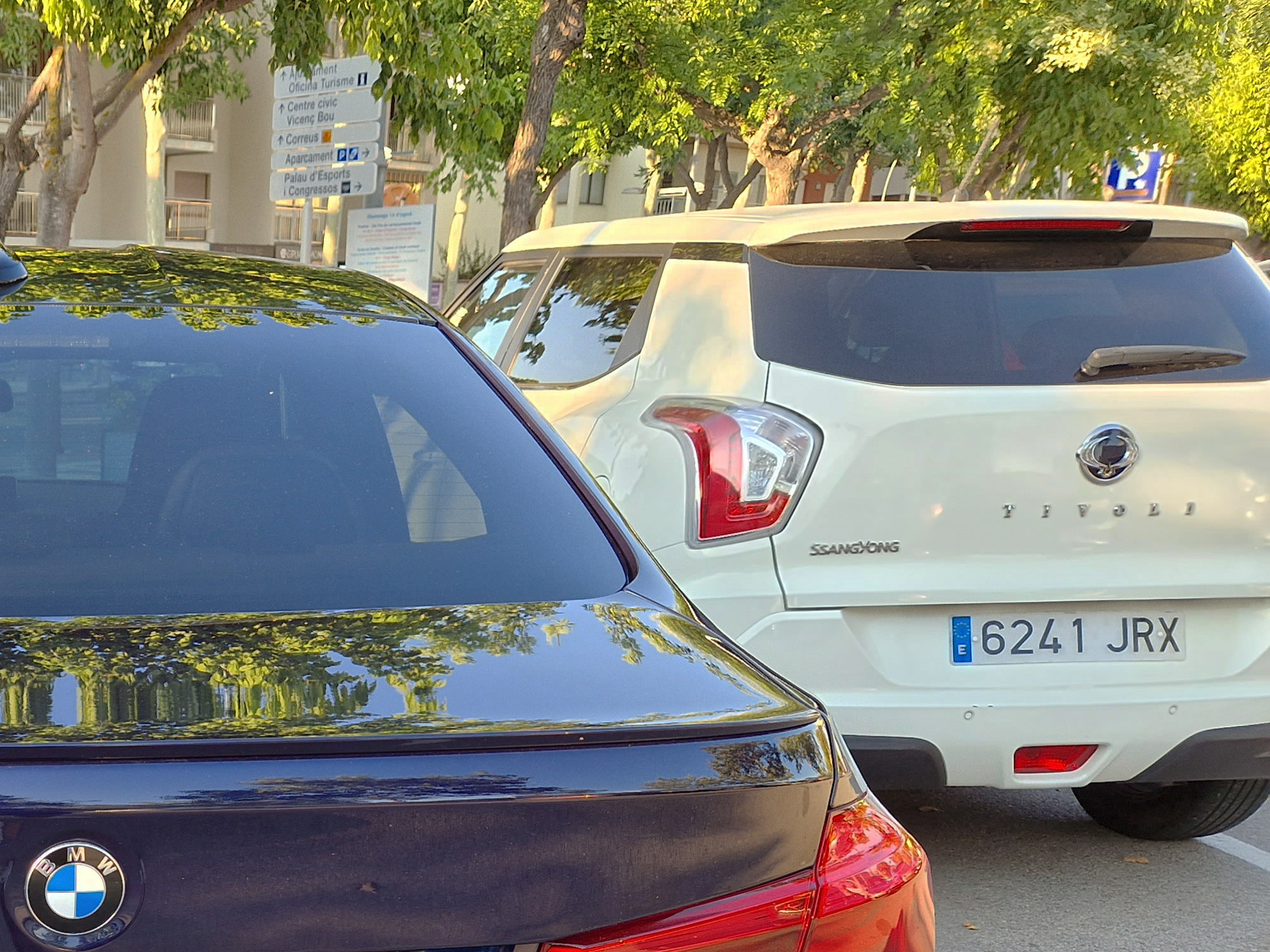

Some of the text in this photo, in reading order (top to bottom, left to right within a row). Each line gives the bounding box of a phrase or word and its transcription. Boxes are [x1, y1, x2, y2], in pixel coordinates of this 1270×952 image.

[289, 64, 338, 81] Ajuament
[288, 81, 317, 93] Oficina
[321, 76, 354, 90] Turisme
[287, 100, 315, 112] Centre
[287, 111, 335, 127] Vicenç Bou
[286, 133, 319, 145] Correus
[285, 150, 333, 166] Aparcament
[285, 169, 350, 183] Palau d'Esports
[288, 184, 338, 197] Congressos
[1002, 502, 1196, 519] TIVOLI
[981, 617, 1180, 655] 6241 JRX
[957, 644, 967, 655] E
[36, 846, 118, 878] BMW
